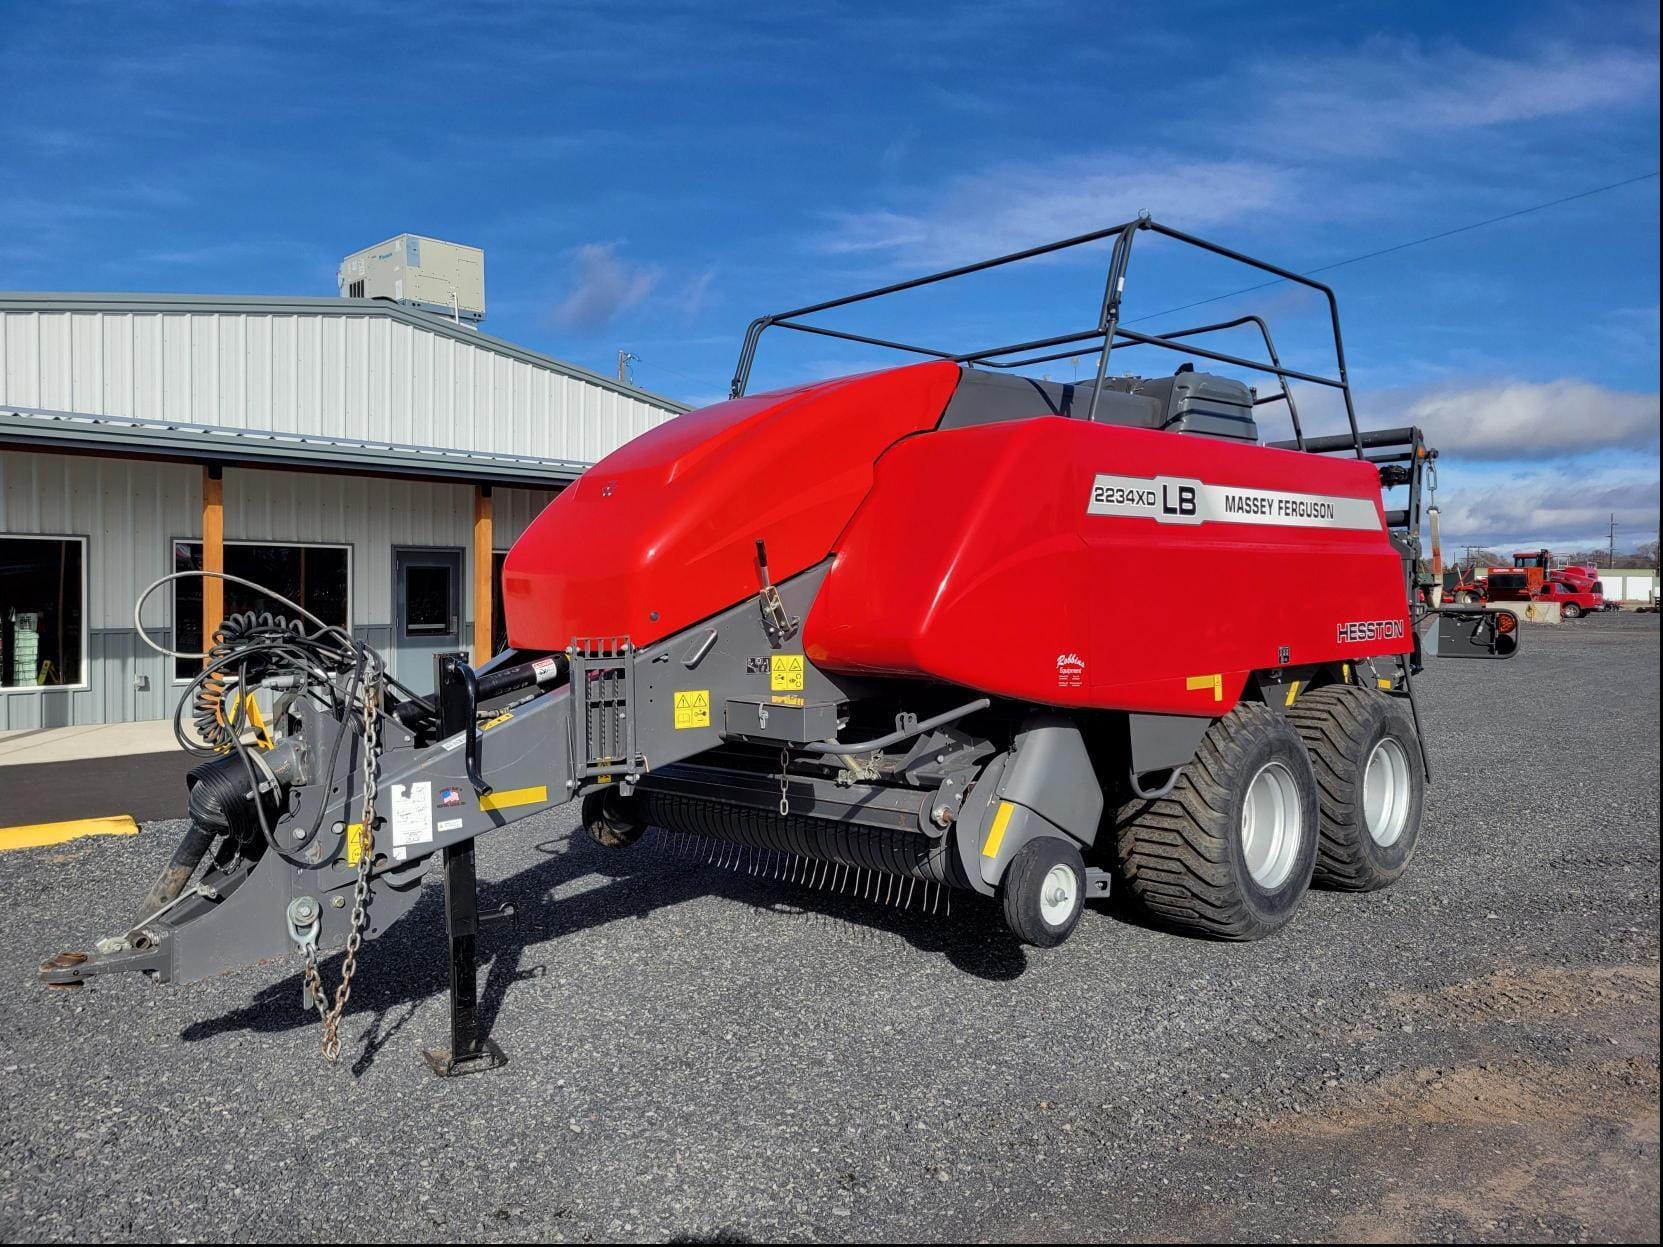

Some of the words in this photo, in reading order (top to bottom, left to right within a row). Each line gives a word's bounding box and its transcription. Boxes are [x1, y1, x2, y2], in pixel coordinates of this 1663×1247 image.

[1094, 486, 1156, 506] 2234XD
[1162, 484, 1197, 516] LB
[1225, 495, 1274, 515] MASSEY
[1278, 500, 1334, 519] FERGUSON
[1337, 620, 1403, 643] HESSTON
[1056, 653, 1085, 668] Robbins
